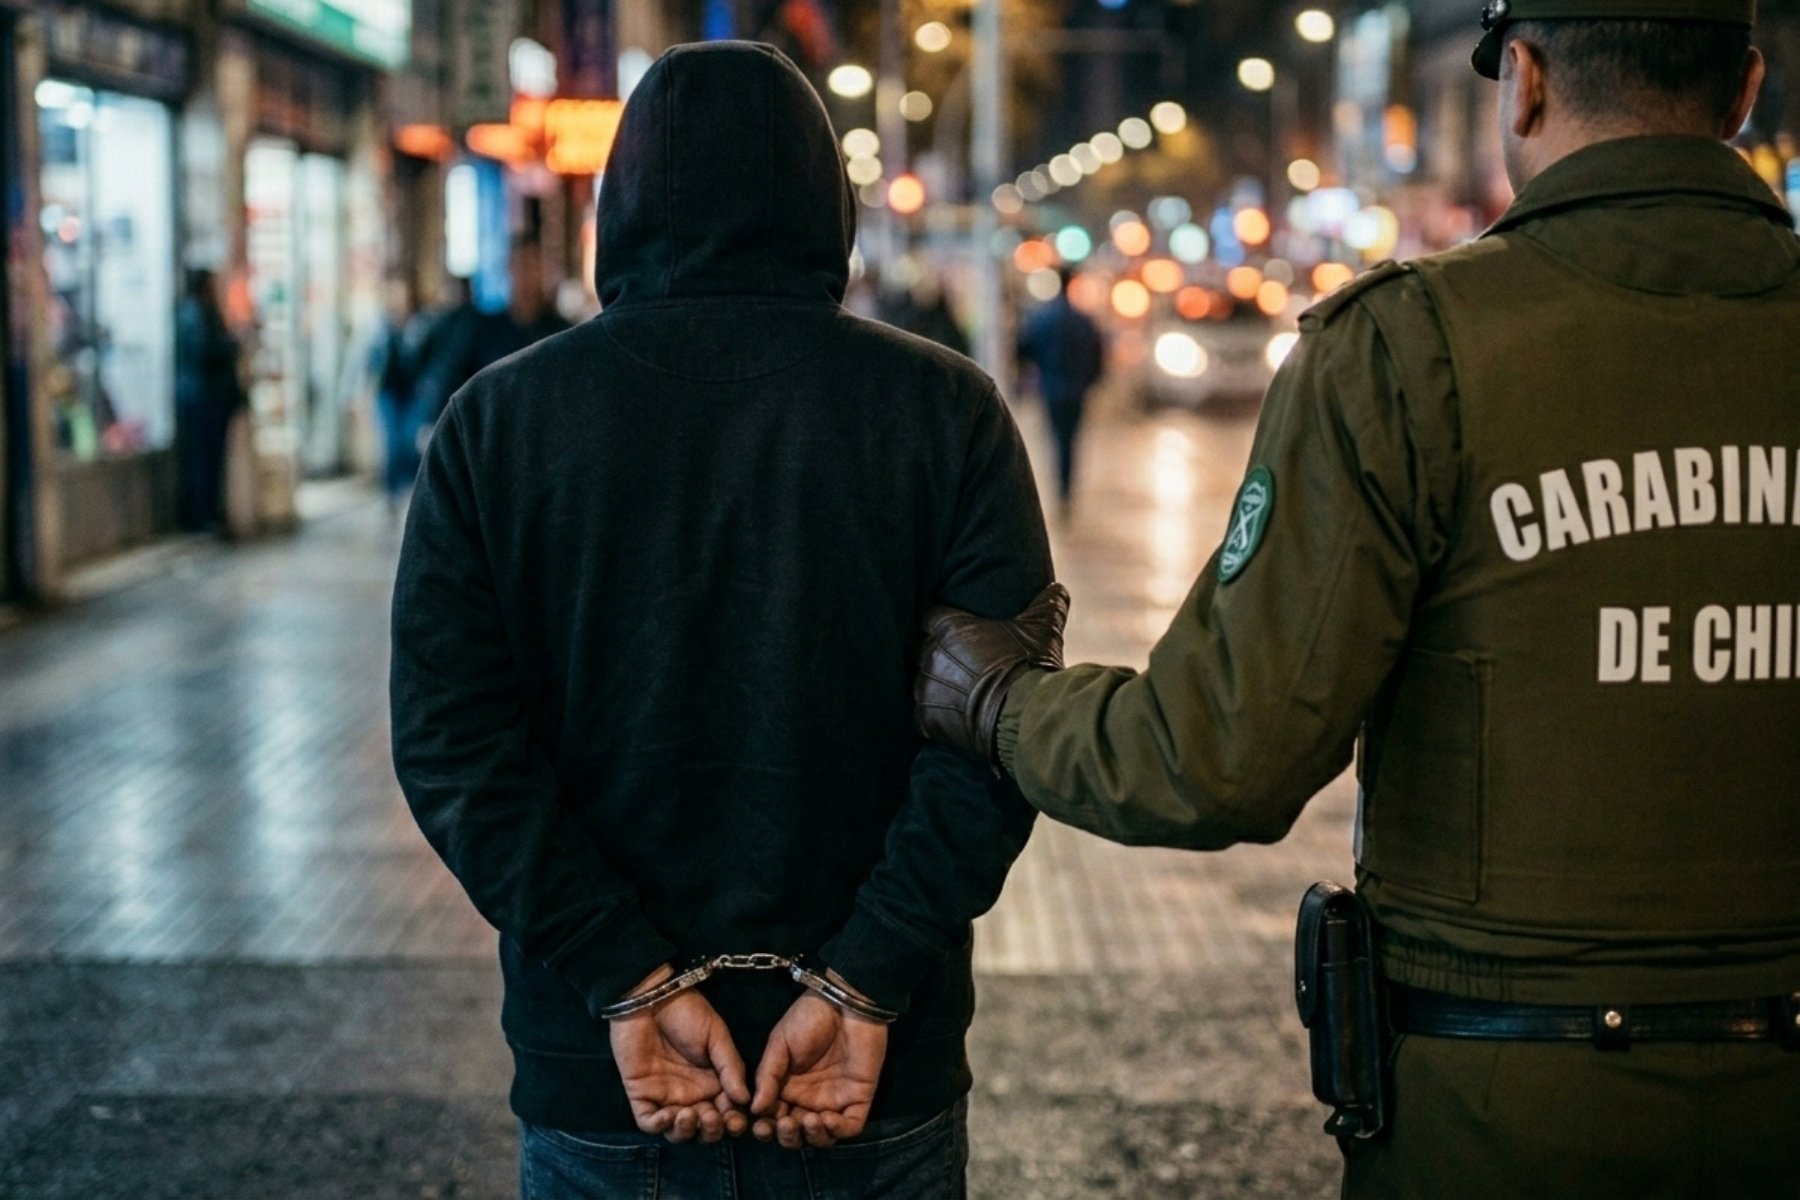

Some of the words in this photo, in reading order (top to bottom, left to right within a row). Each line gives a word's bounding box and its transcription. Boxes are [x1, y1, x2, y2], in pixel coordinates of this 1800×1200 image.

[1490, 445, 1800, 562] CARABIN
[1598, 606, 1671, 682] DE
[1693, 604, 1800, 682] CHI
